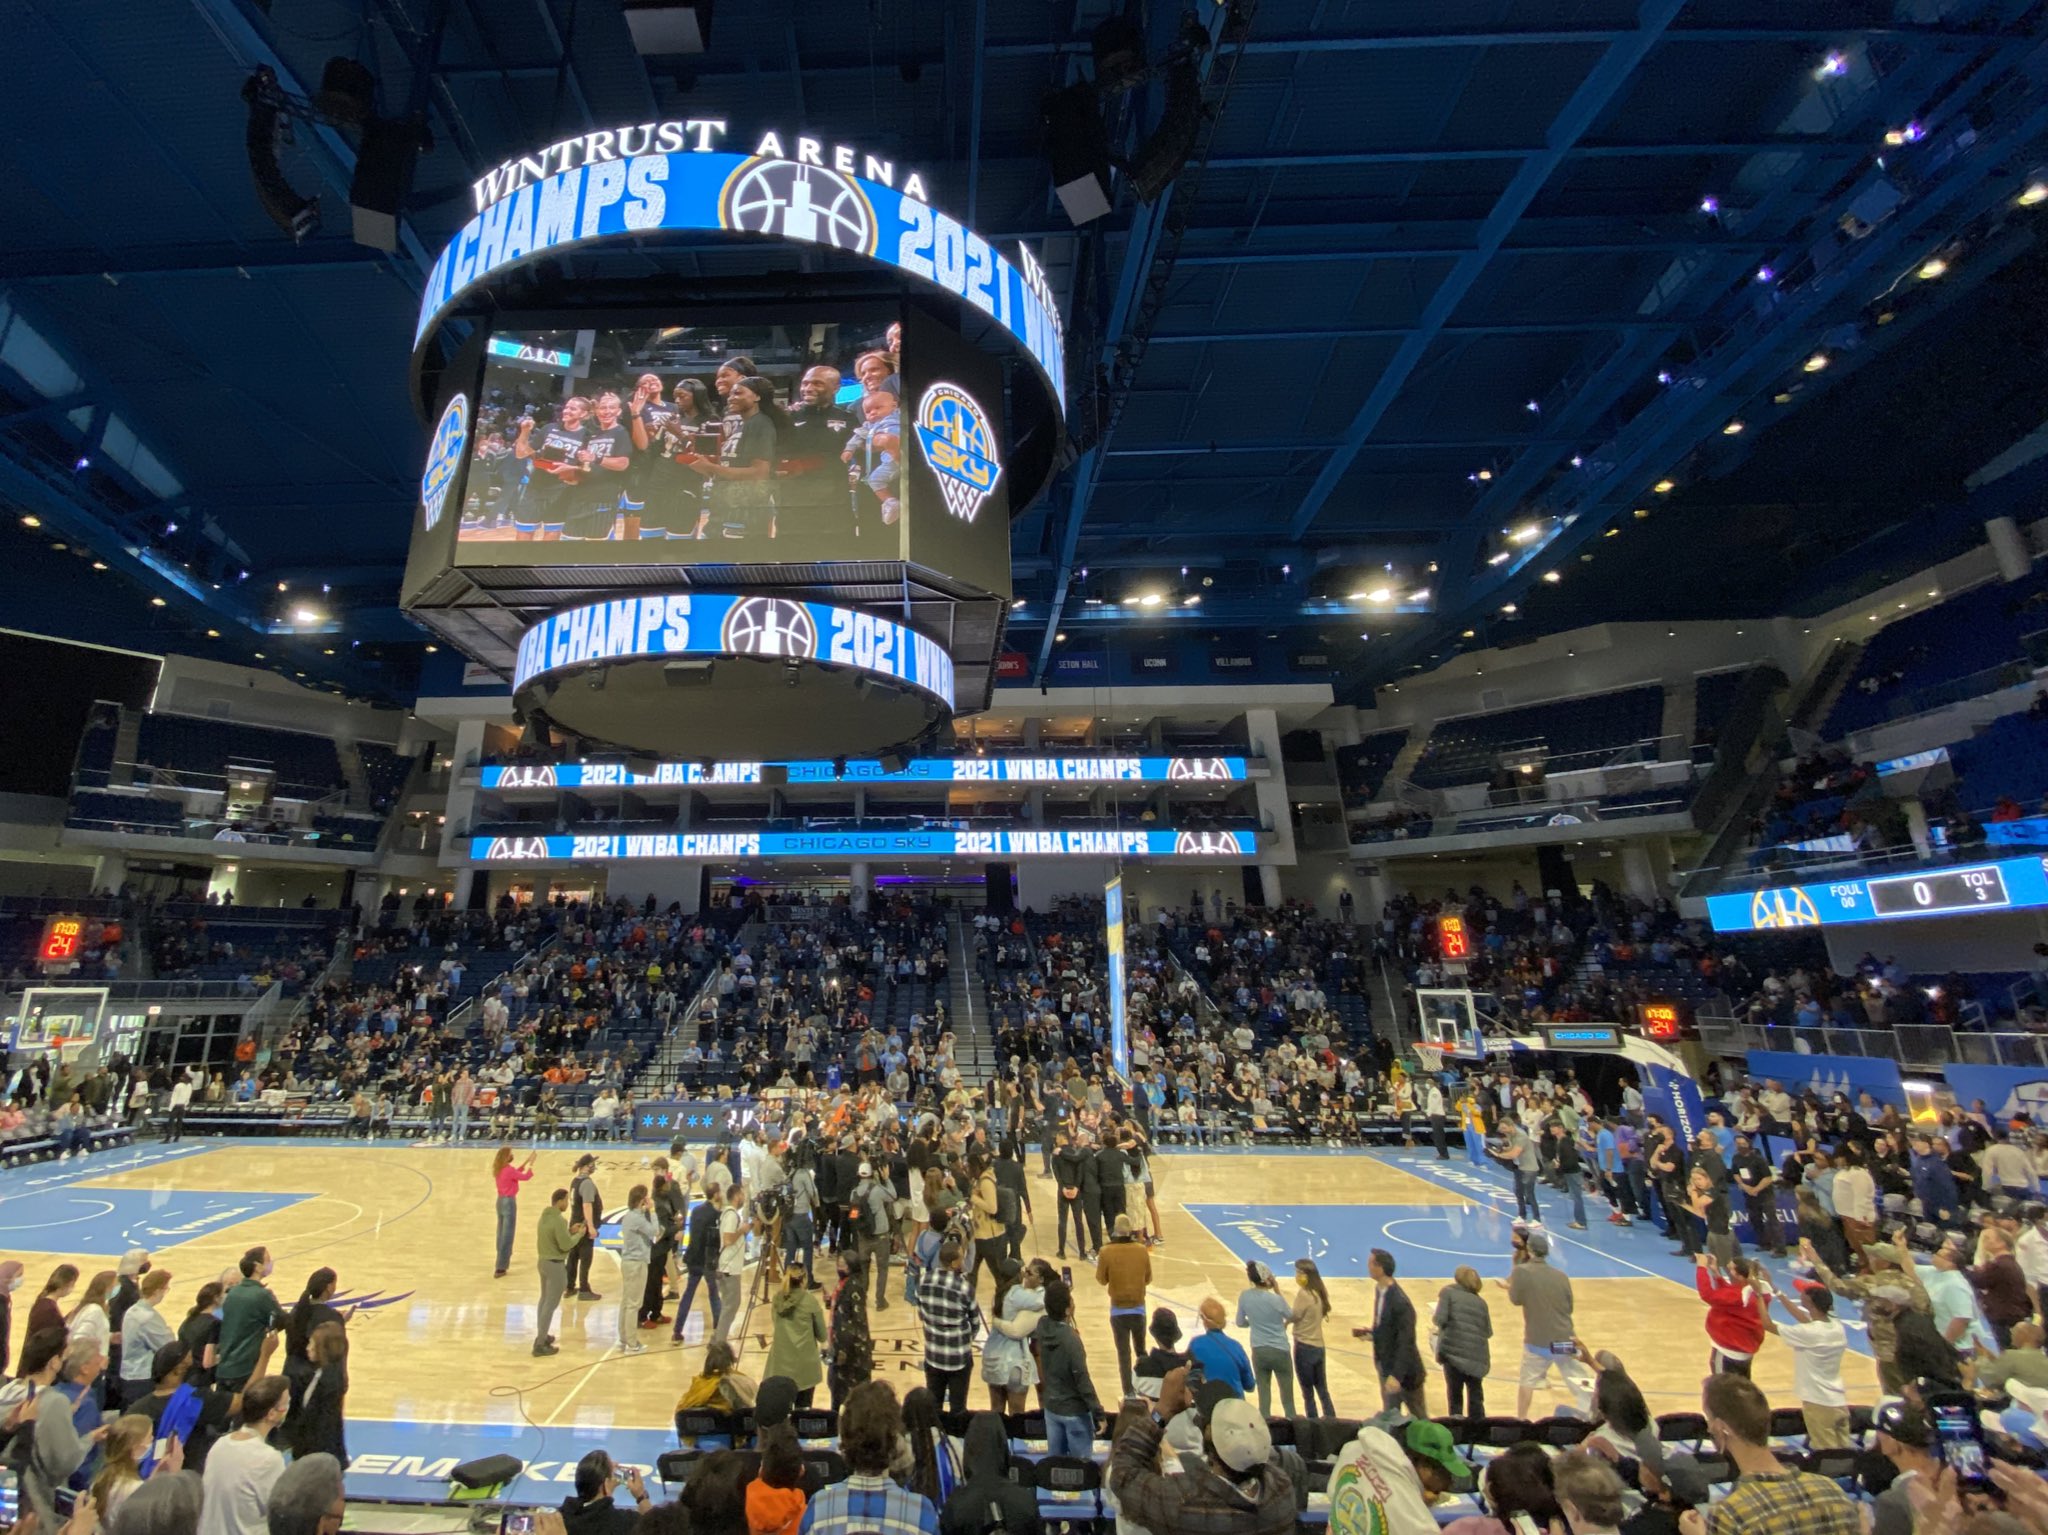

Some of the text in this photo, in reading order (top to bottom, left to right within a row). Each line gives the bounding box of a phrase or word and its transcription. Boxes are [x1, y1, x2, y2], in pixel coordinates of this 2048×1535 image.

[472, 119, 928, 214] WINTRUST ARENA
[451, 154, 671, 300] CHAMPS
[899, 195, 1012, 328] 2021
[550, 595, 692, 670] CHAMPS
[831, 597, 906, 680] 2021
[1058, 660, 1099, 669] SETON HALL
[1143, 658, 1167, 668] UCONN
[580, 764, 626, 785] 2021
[685, 762, 761, 784] CAMPS
[952, 760, 998, 781] 2021
[1005, 759, 1059, 781] WNBA
[1062, 758, 1142, 780] CHAMPS
[572, 836, 619, 858] 2021
[626, 835, 678, 858] WNBA
[682, 833, 761, 857] CHAMPS
[784, 837, 886, 850] CHICAGO
[954, 832, 1001, 855] 2021
[1007, 832, 1065, 854] WNBA
[1067, 831, 1150, 854] CHAMPS
[1829, 883, 1864, 898] FOUL
[1912, 881, 1932, 906] 0
[1960, 872, 1995, 902] TOL 3
[54, 921, 79, 936] 17:00
[48, 935, 73, 956] 24
[1447, 933, 1465, 956] 24
[1647, 1008, 1673, 1020] 17:00
[1652, 1020, 1671, 1034] 24
[1671, 1091, 1696, 1142] HORIZON
[1236, 1225, 1285, 1255] WNBA
